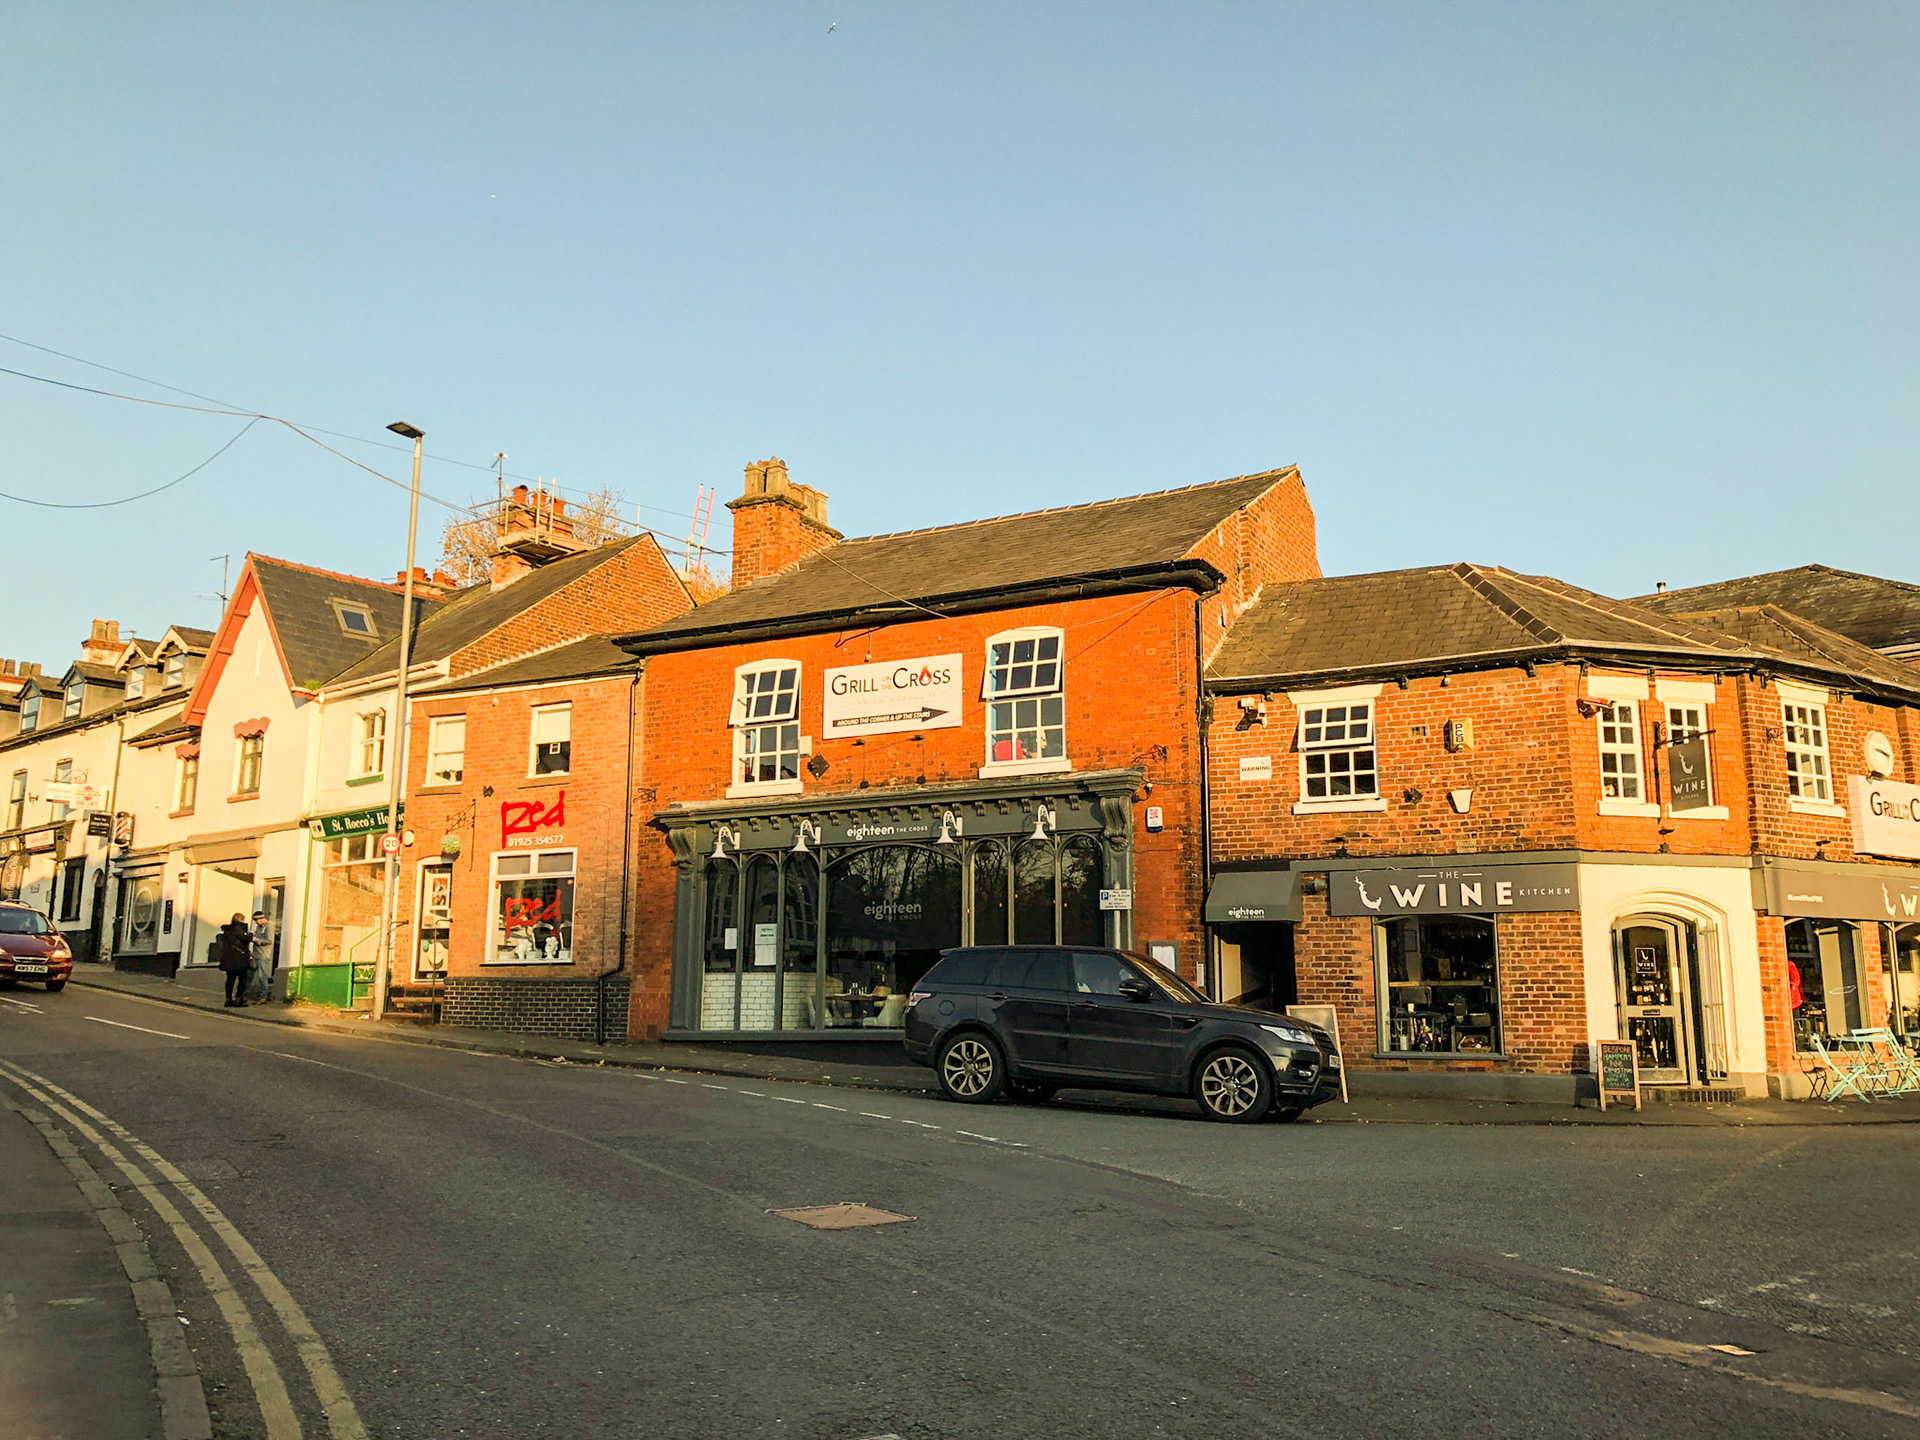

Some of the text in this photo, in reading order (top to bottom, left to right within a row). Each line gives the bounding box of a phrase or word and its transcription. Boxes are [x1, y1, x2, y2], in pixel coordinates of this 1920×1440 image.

[831, 674, 879, 696] GRILL
[836, 719, 859, 727] AROUND
[869, 715, 890, 724] CORNER
[913, 710, 931, 719] STAIRS
[1673, 779, 1706, 794] WINE
[331, 819, 344, 832] St.
[344, 814, 375, 830] Rocco's
[508, 834, 564, 847] 01925 354577
[846, 823, 895, 841] eighteen
[384, 839, 398, 847] 20
[1439, 871, 1459, 879] THE
[1389, 881, 1572, 908] WINE KITCHEN
[864, 900, 922, 920] eighteen
[1228, 906, 1265, 919] eighteen
